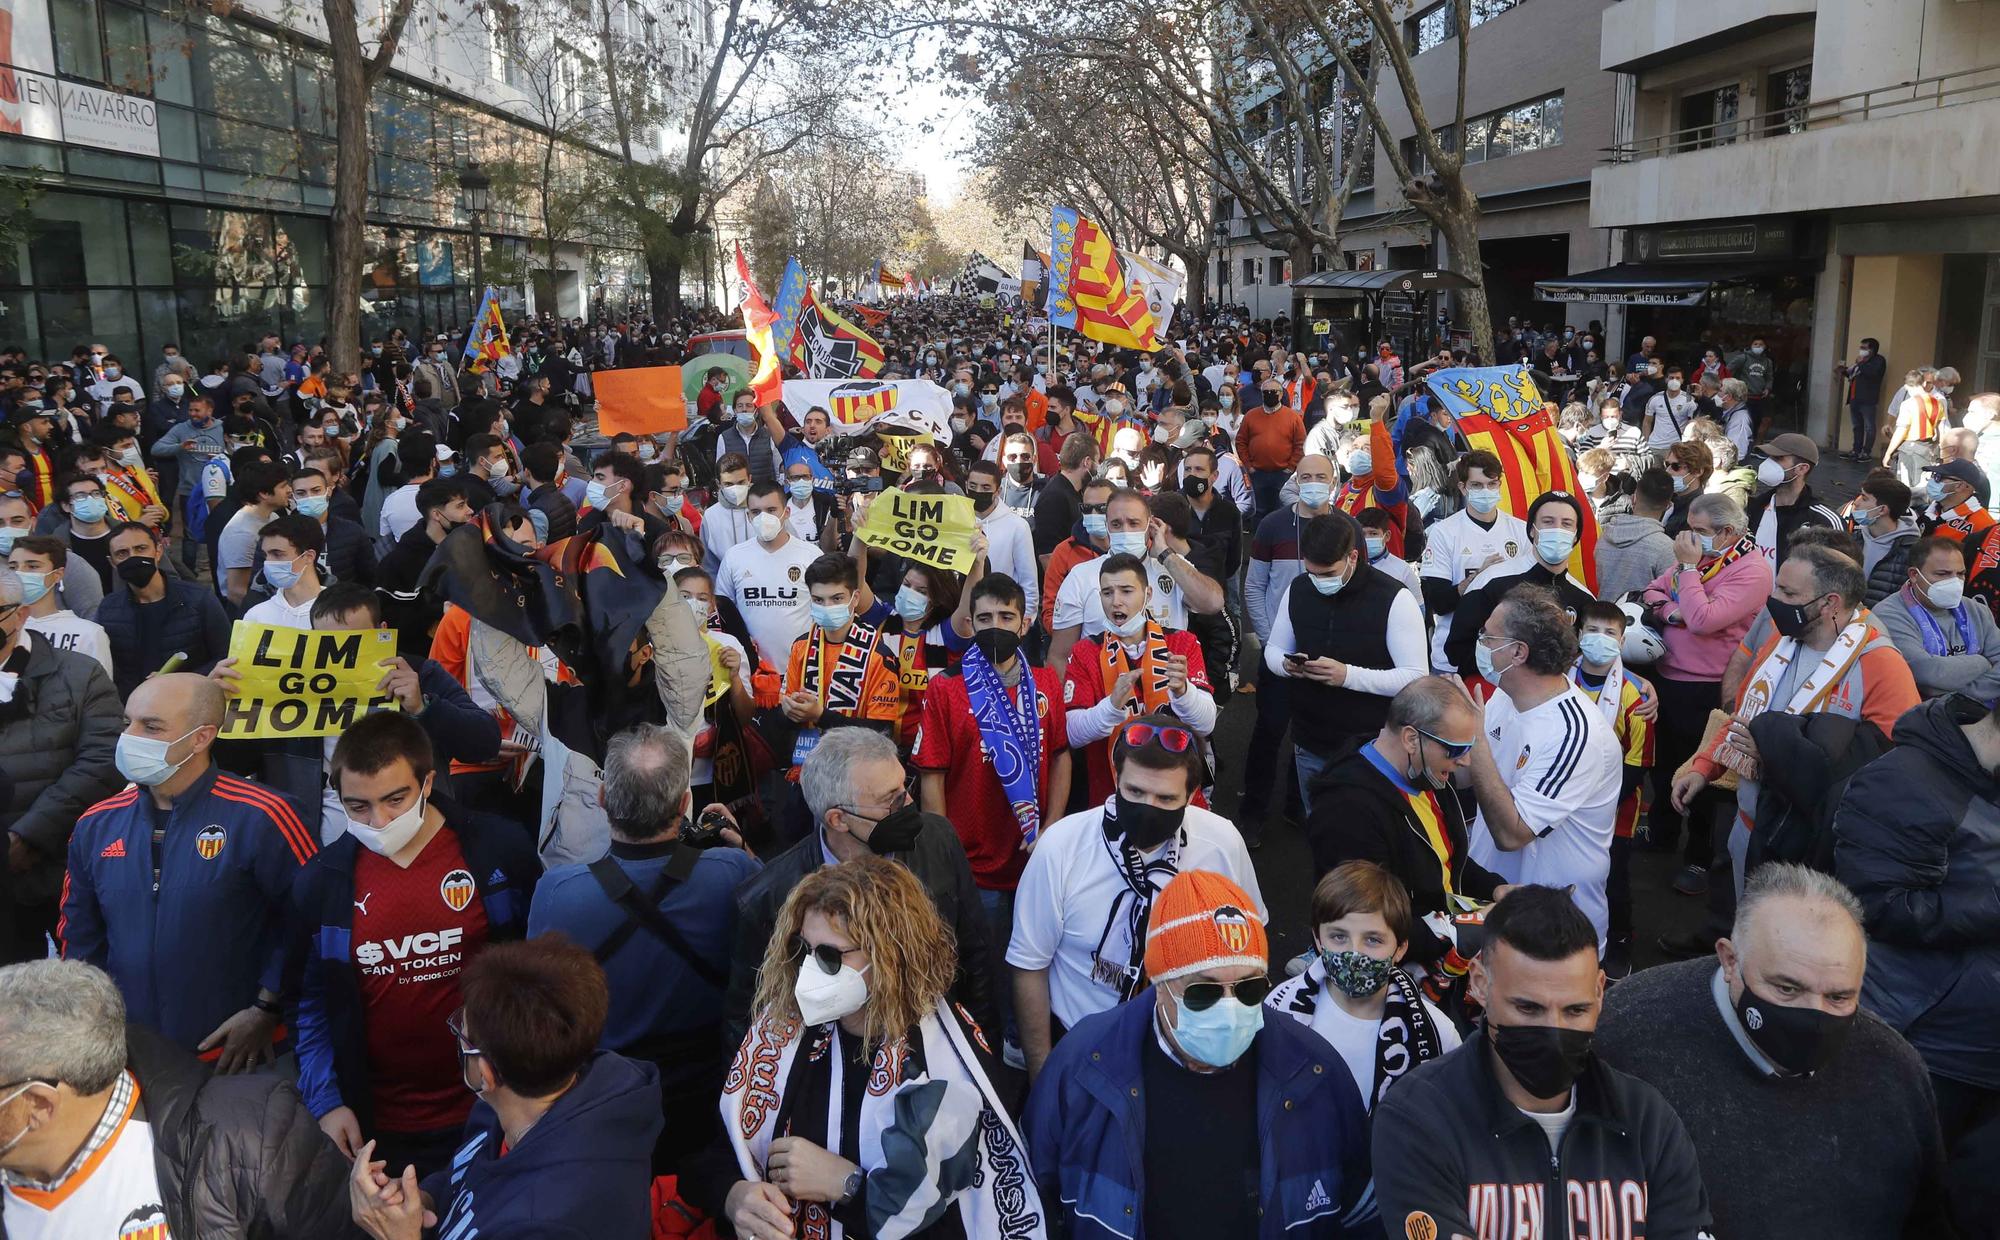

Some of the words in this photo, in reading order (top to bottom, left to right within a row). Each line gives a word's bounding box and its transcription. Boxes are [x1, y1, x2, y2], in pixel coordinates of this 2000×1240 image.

[60, 86, 155, 127] NAVARRO
[1589, 293, 1628, 302] FUTBOLISTAS
[1634, 294, 1665, 304] VALENCIA
[1666, 295, 1680, 304] C.F.
[890, 438, 916, 451] LIM
[892, 495, 944, 523] LIM
[894, 521, 939, 542] GO
[867, 534, 957, 566] HOME
[252, 629, 363, 670] LIM
[279, 672, 337, 695] GO
[355, 927, 463, 967] $VCF
[362, 964, 395, 976] FAN
[400, 952, 462, 972] TOKEN
[399, 976, 411, 985] by
[1305, 1196, 1331, 1211] adidas
